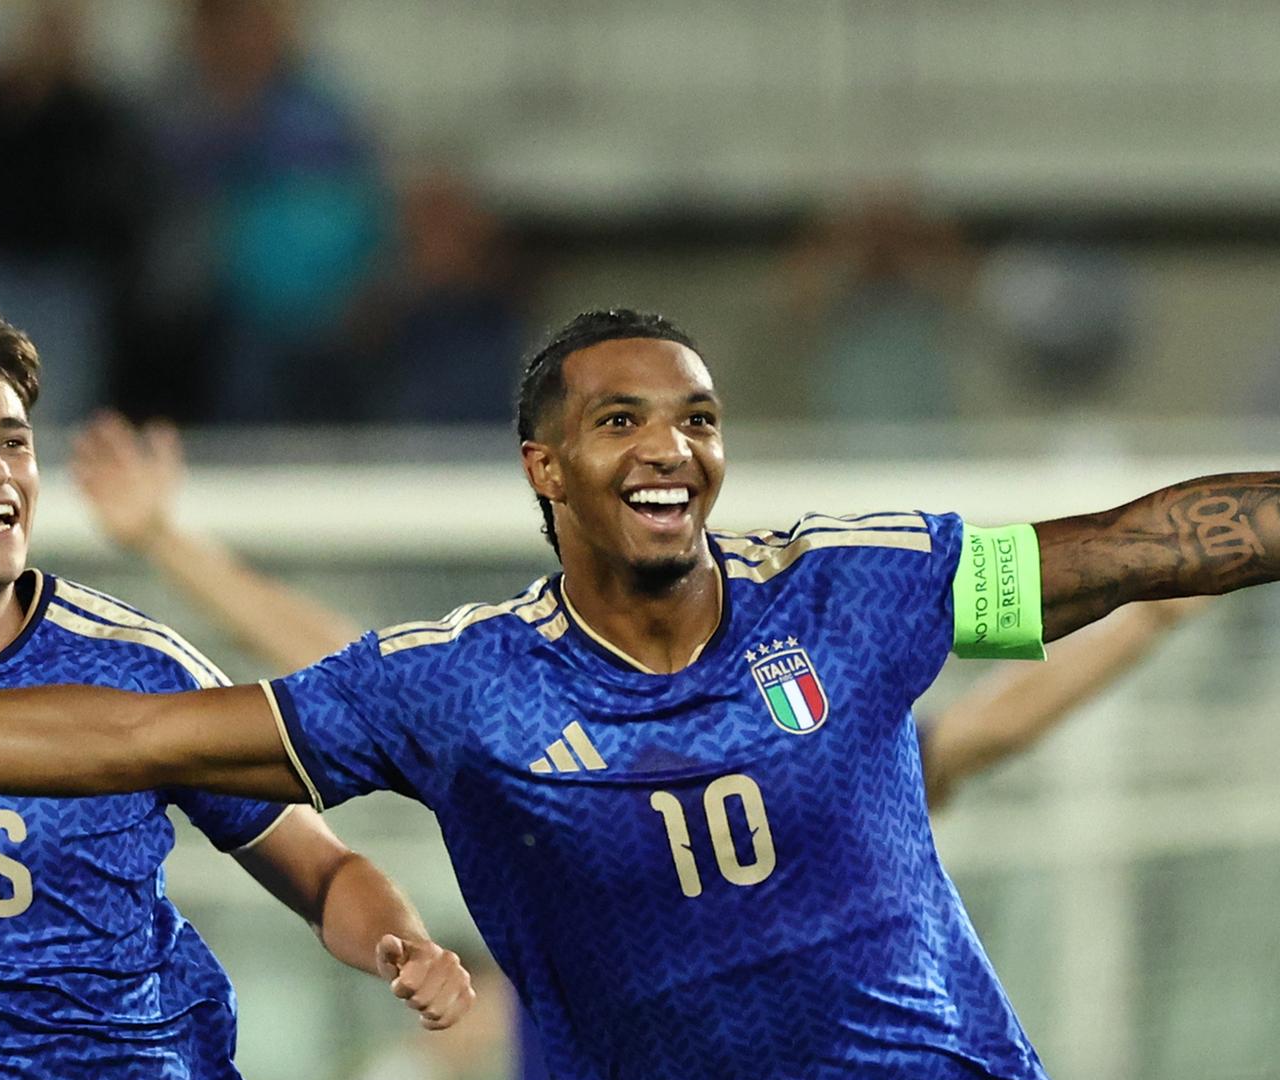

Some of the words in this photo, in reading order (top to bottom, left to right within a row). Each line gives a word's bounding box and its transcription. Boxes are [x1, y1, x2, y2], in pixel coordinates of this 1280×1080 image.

[969, 534, 987, 592] RACISM
[996, 538, 1015, 607] RESPECT
[975, 597, 988, 620] TO
[756, 654, 807, 683] ITALIA
[649, 773, 777, 898] 10
